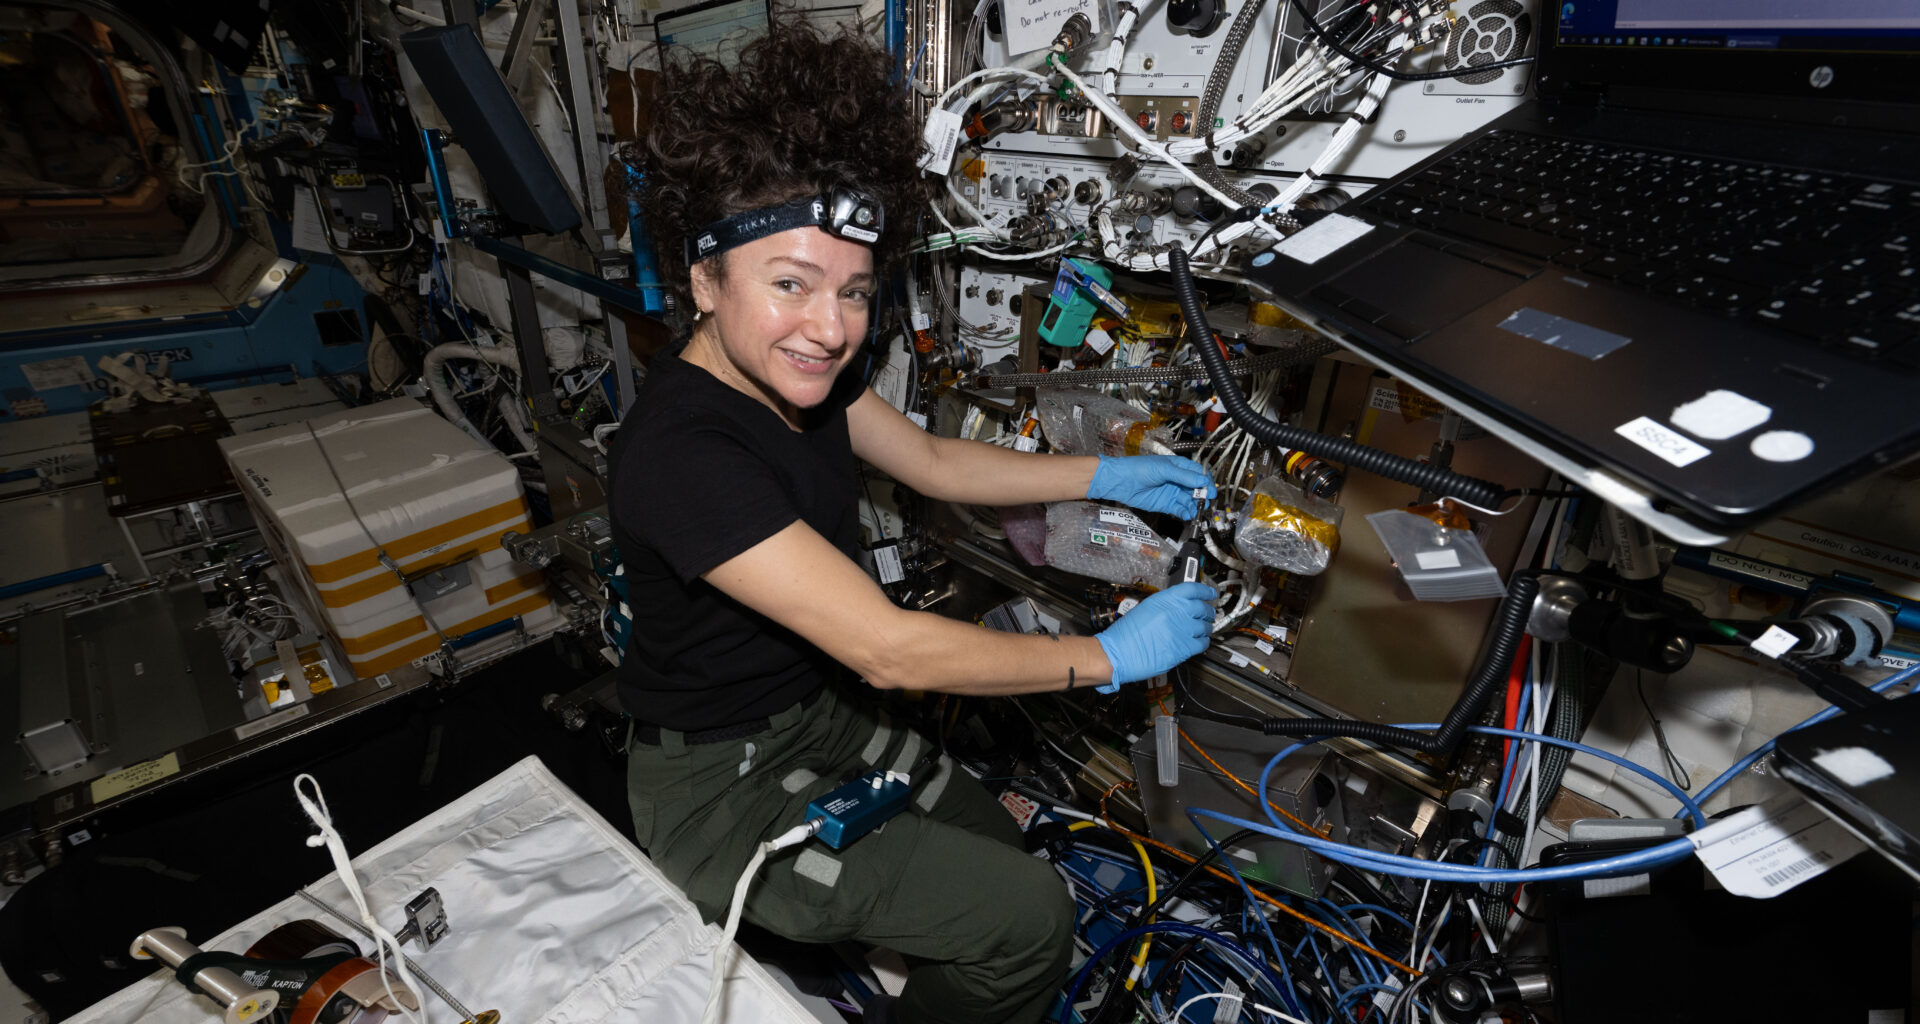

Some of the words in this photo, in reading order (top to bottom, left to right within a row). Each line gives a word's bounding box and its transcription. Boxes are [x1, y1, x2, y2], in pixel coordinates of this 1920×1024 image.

[1020, 16, 1031, 28] Do
[1035, 11, 1050, 23] not
[1812, 67, 1832, 88] hp
[736, 213, 777, 234] TIKKA
[697, 233, 718, 256] PETZL
[144, 347, 191, 364] DECK
[1116, 532, 1133, 540] Under
[1134, 536, 1159, 546] Pressure
[1128, 527, 1150, 537] KEEP
[1800, 532, 1846, 551] Caution:
[1850, 545, 1881, 559] OGS
[1881, 554, 1909, 568] AAA
[1716, 555, 1737, 566] DO
[1741, 560, 1773, 576] NOT
[1729, 827, 1759, 846] Ethernet
[271, 980, 304, 990] KAPTON
